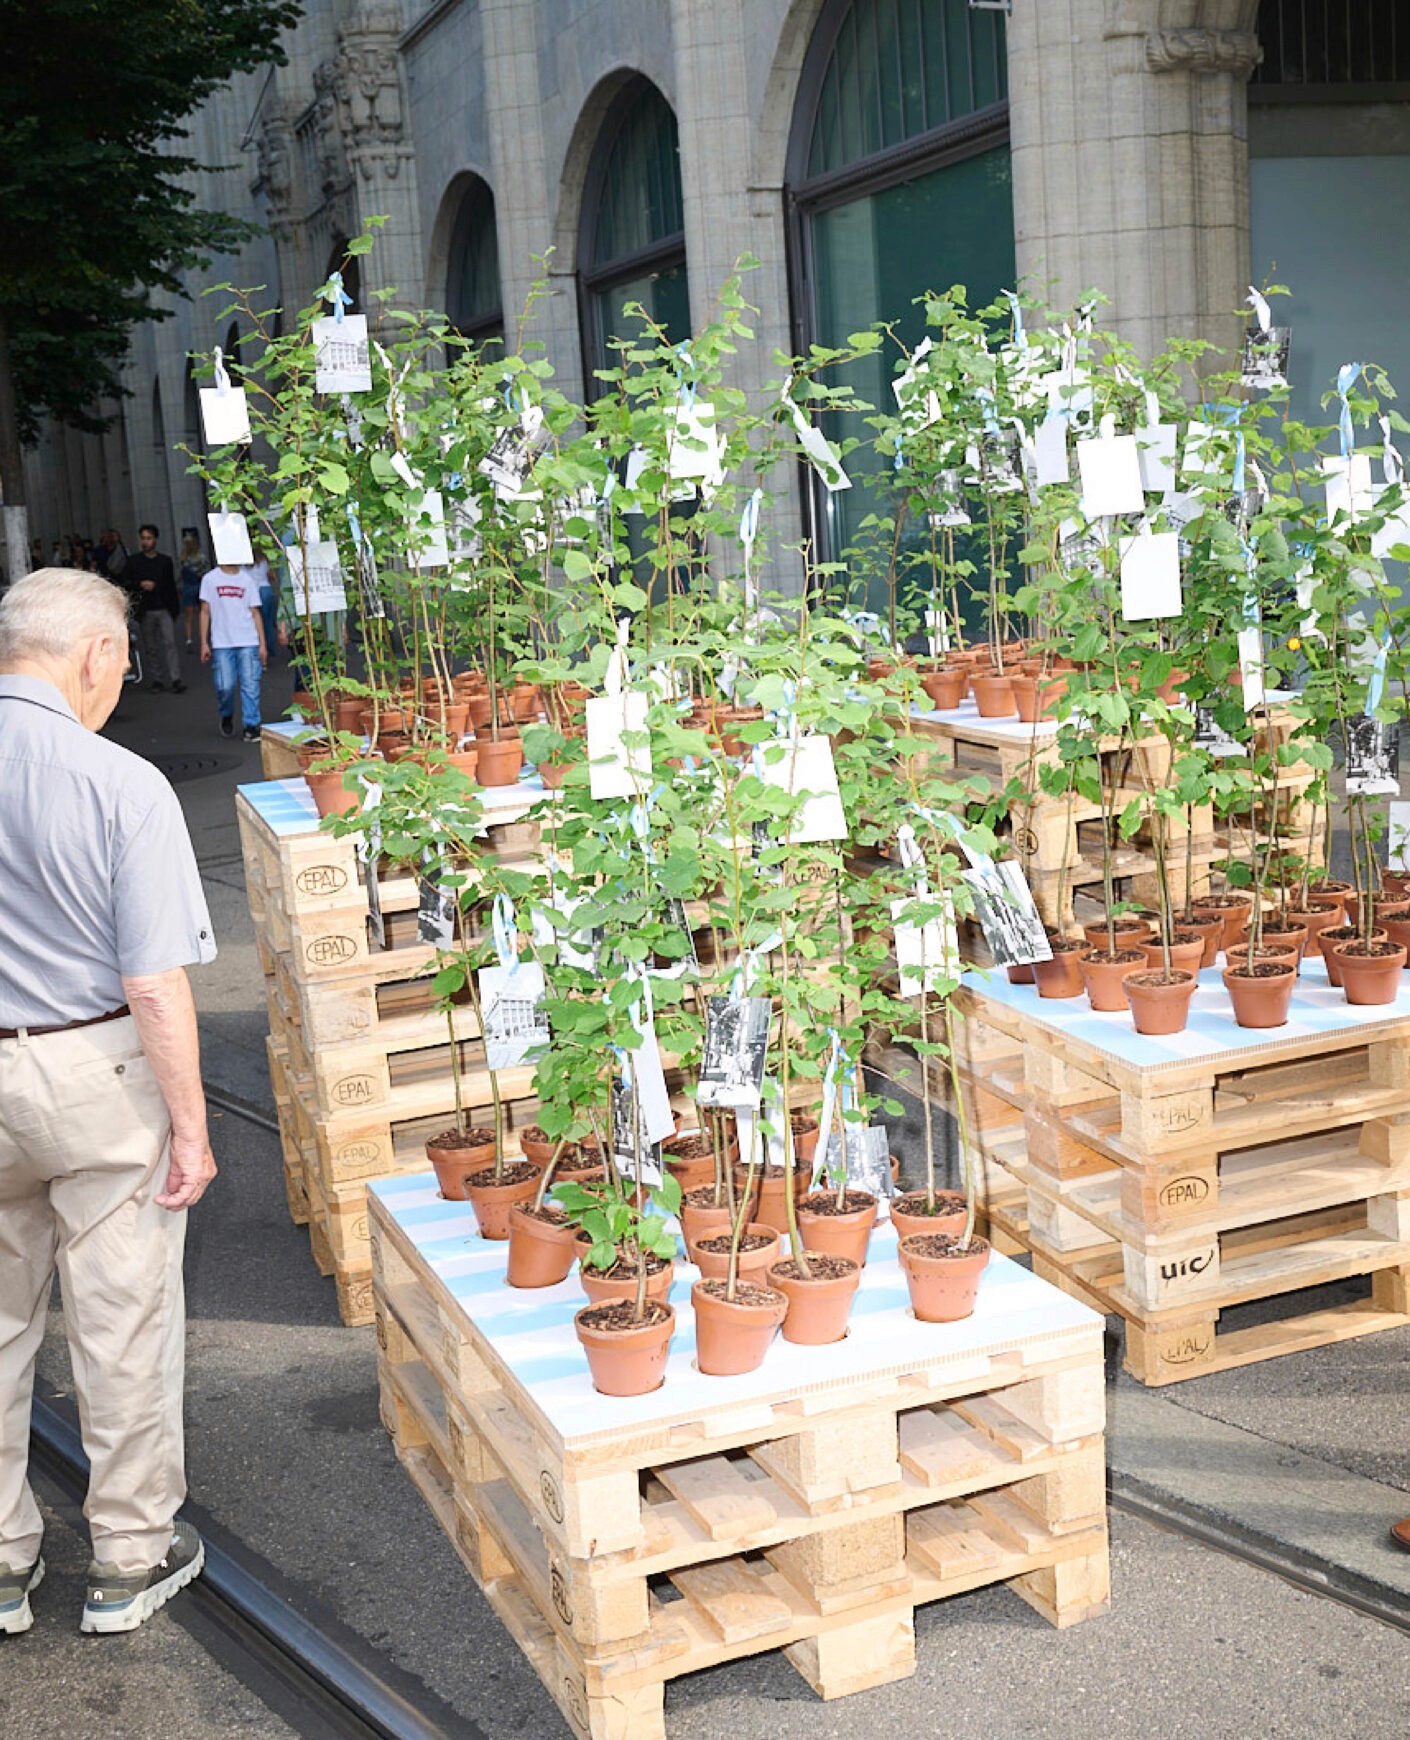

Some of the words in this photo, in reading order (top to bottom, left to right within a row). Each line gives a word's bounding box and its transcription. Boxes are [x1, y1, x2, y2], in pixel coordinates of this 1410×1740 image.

[304, 868, 340, 891] EPAL
[314, 938, 350, 962] EPAL
[338, 1080, 374, 1101] EPAL
[1167, 1182, 1202, 1206] EPAL
